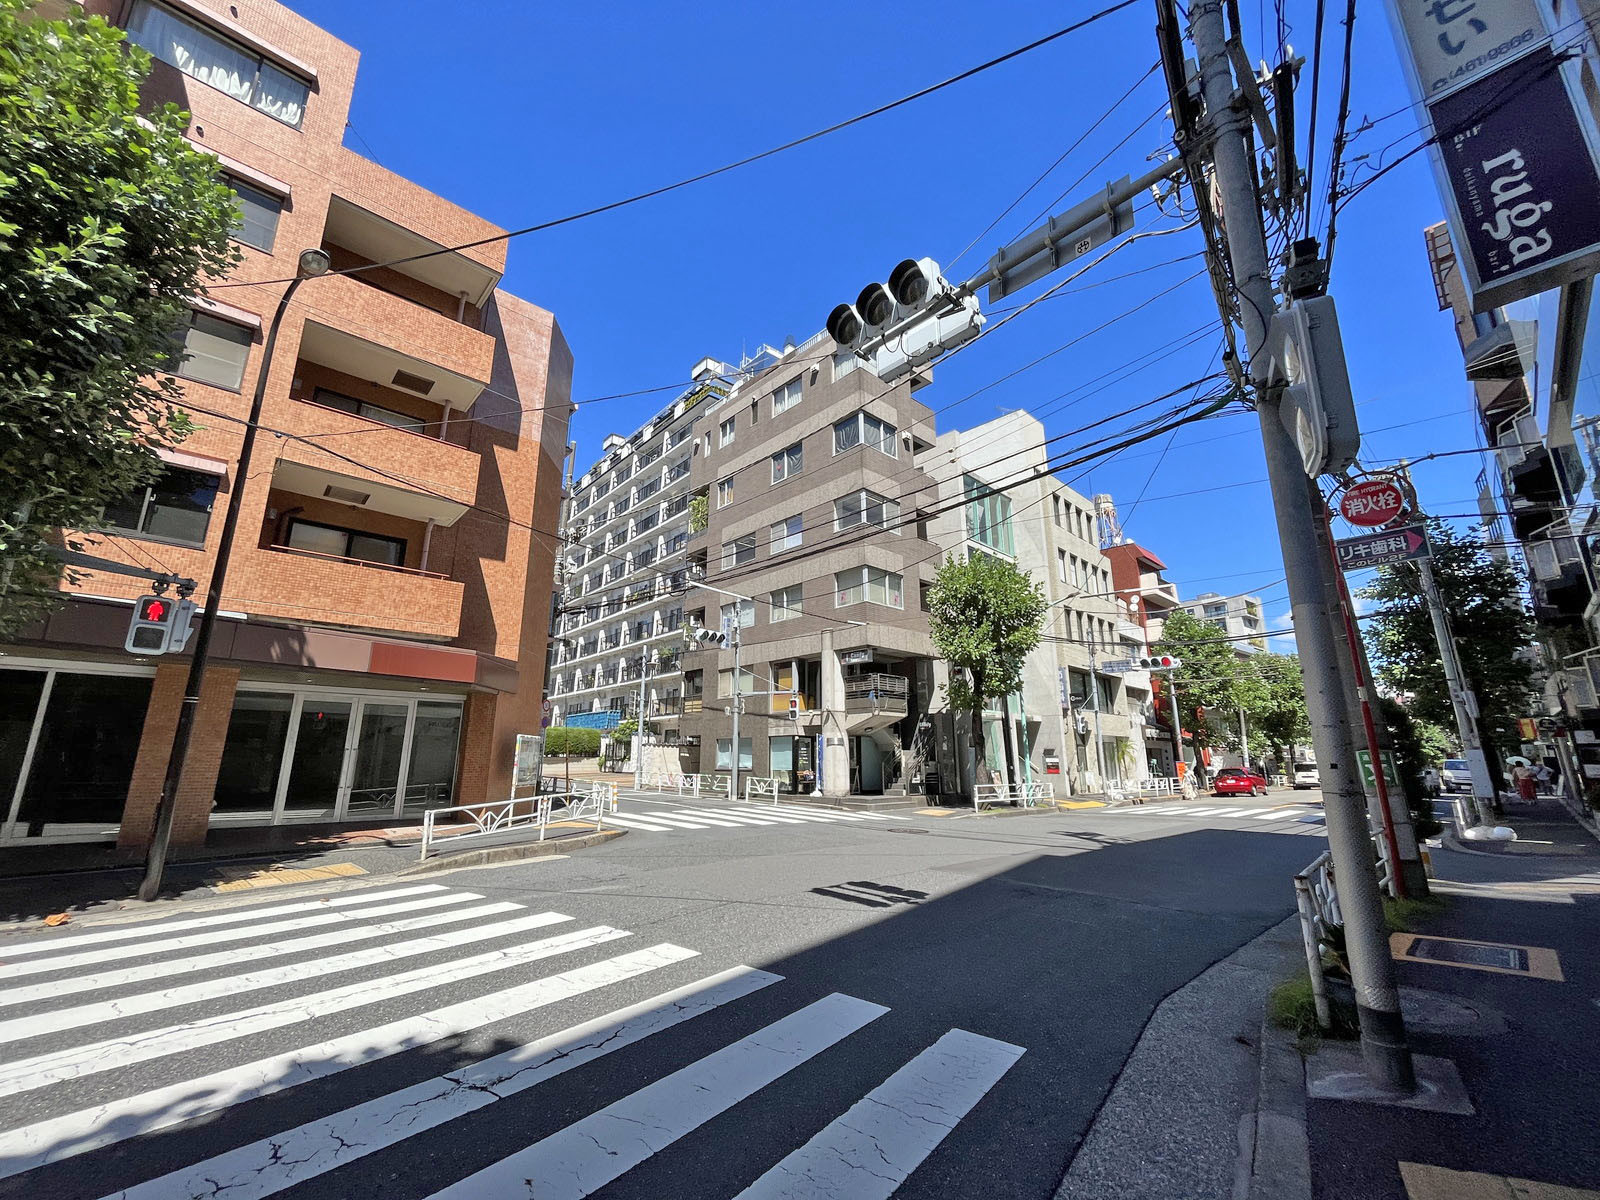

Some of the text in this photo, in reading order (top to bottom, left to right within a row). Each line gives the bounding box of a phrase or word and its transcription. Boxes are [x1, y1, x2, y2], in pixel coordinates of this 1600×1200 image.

[1463, 168, 1499, 265] daikanyama bar
[1482, 148, 1553, 265] ruga
[1361, 484, 1387, 494] HYDRANT
[1345, 491, 1398, 517] 消火栓
[1340, 536, 1406, 560] リキ歯科
[1348, 553, 1407, 568] このビル2F
